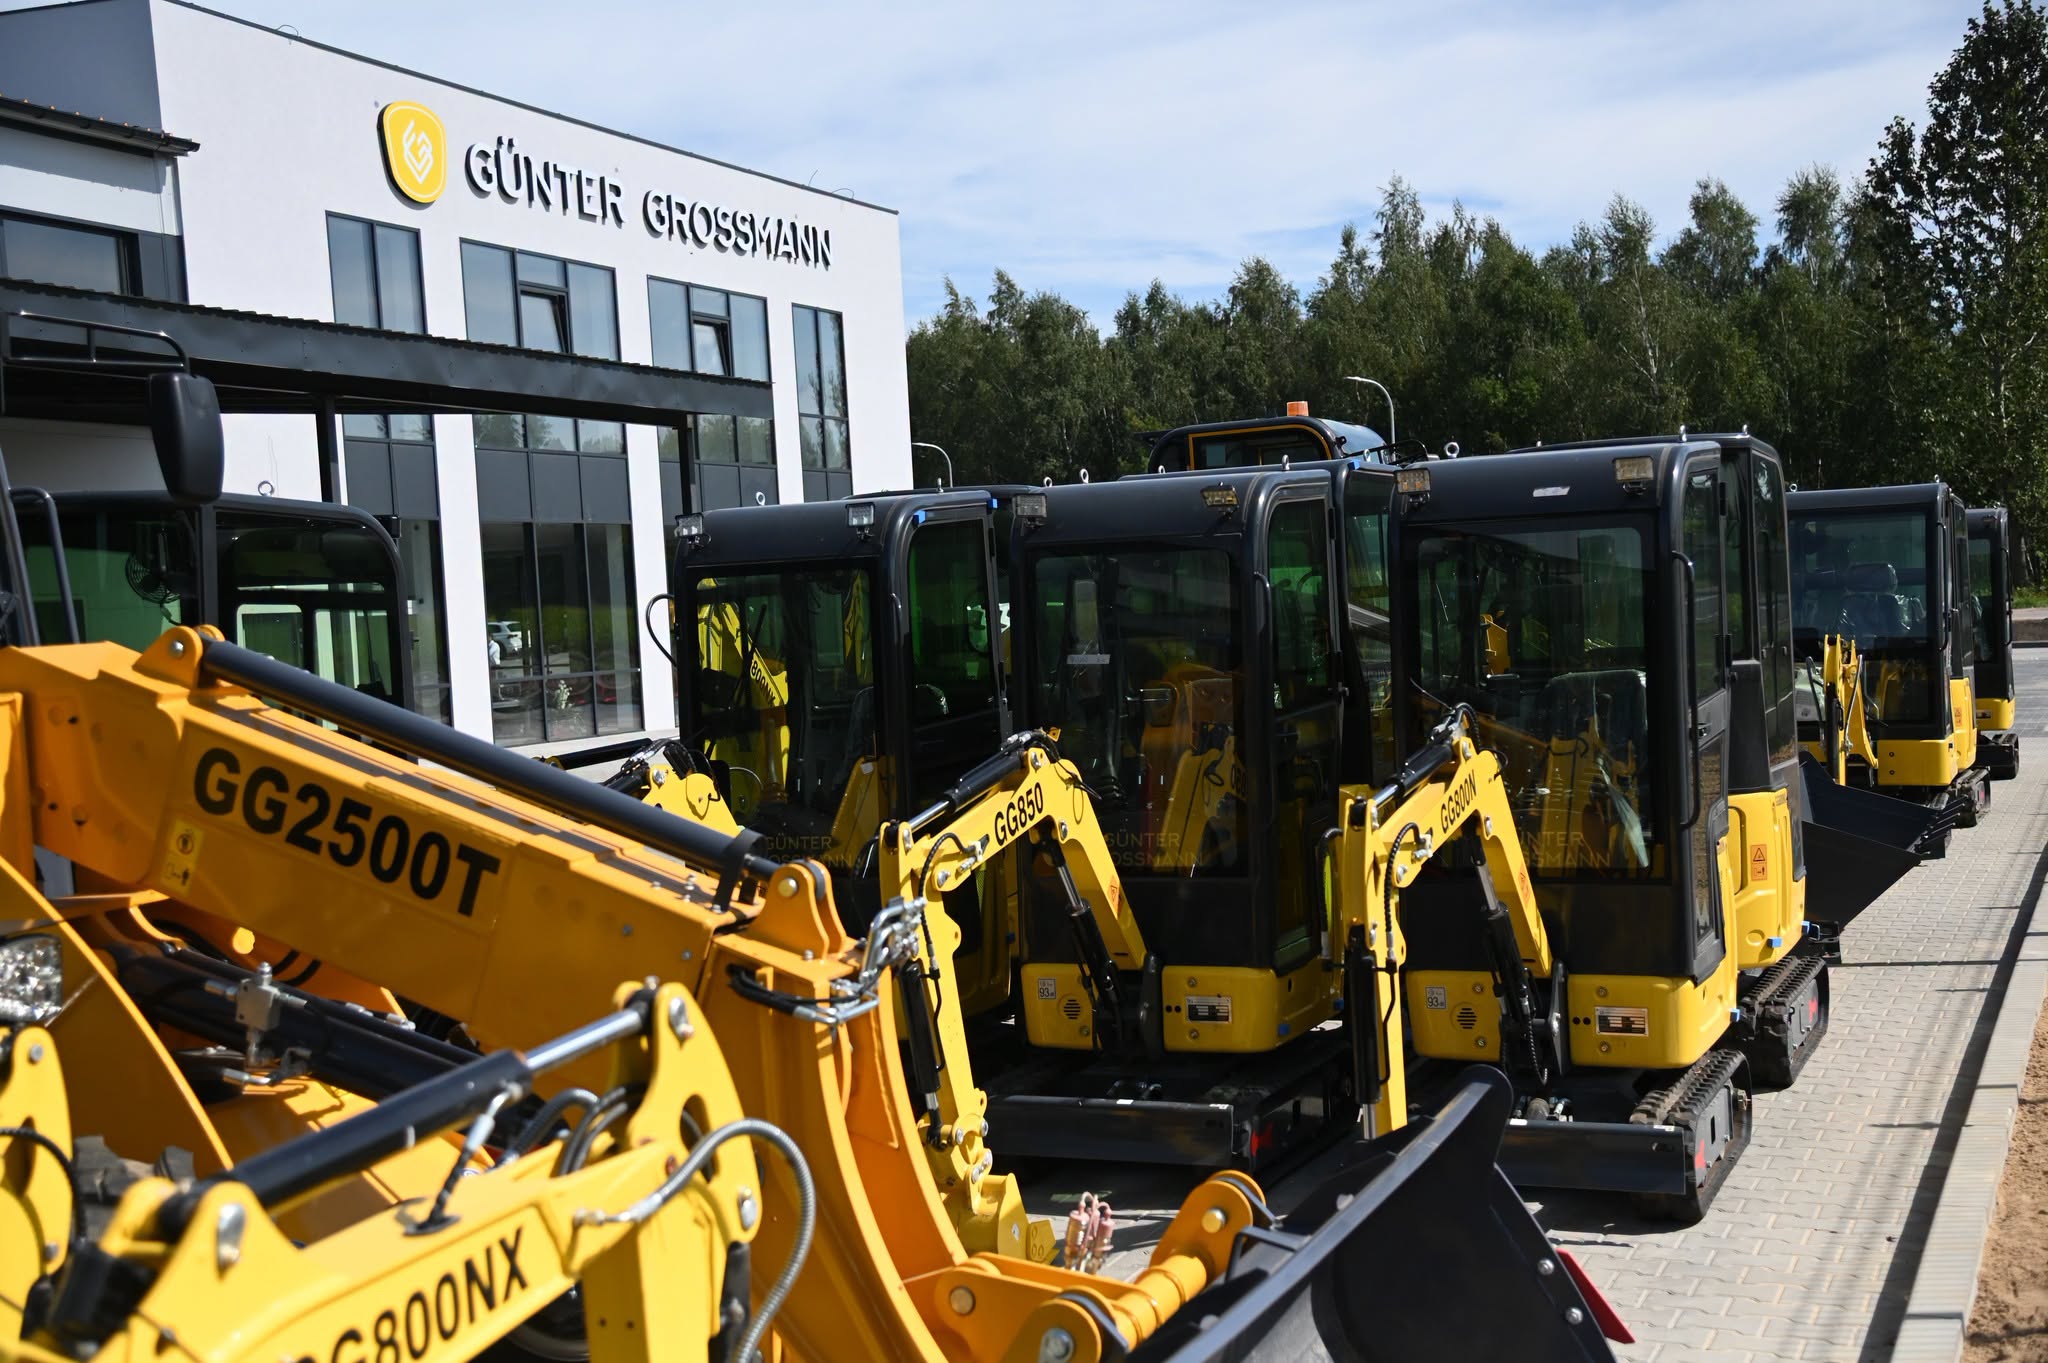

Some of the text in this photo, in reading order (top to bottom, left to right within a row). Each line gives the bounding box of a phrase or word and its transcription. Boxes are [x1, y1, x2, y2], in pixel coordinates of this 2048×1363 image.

[465, 135, 833, 268] GÜNTER GROSSMANN
[1440, 768, 1477, 834] GG800N
[994, 782, 1044, 846] GG850
[194, 747, 501, 917] GG2500T
[768, 832, 832, 850] GÜNTER
[1105, 828, 1180, 848] GÜNTER
[1521, 831, 1585, 847] NTER
[1111, 850, 1204, 866] OSSMANN
[1039, 987, 1050, 998] 93
[1427, 996, 1439, 1008] 93
[296, 1226, 528, 1363] G800NX
